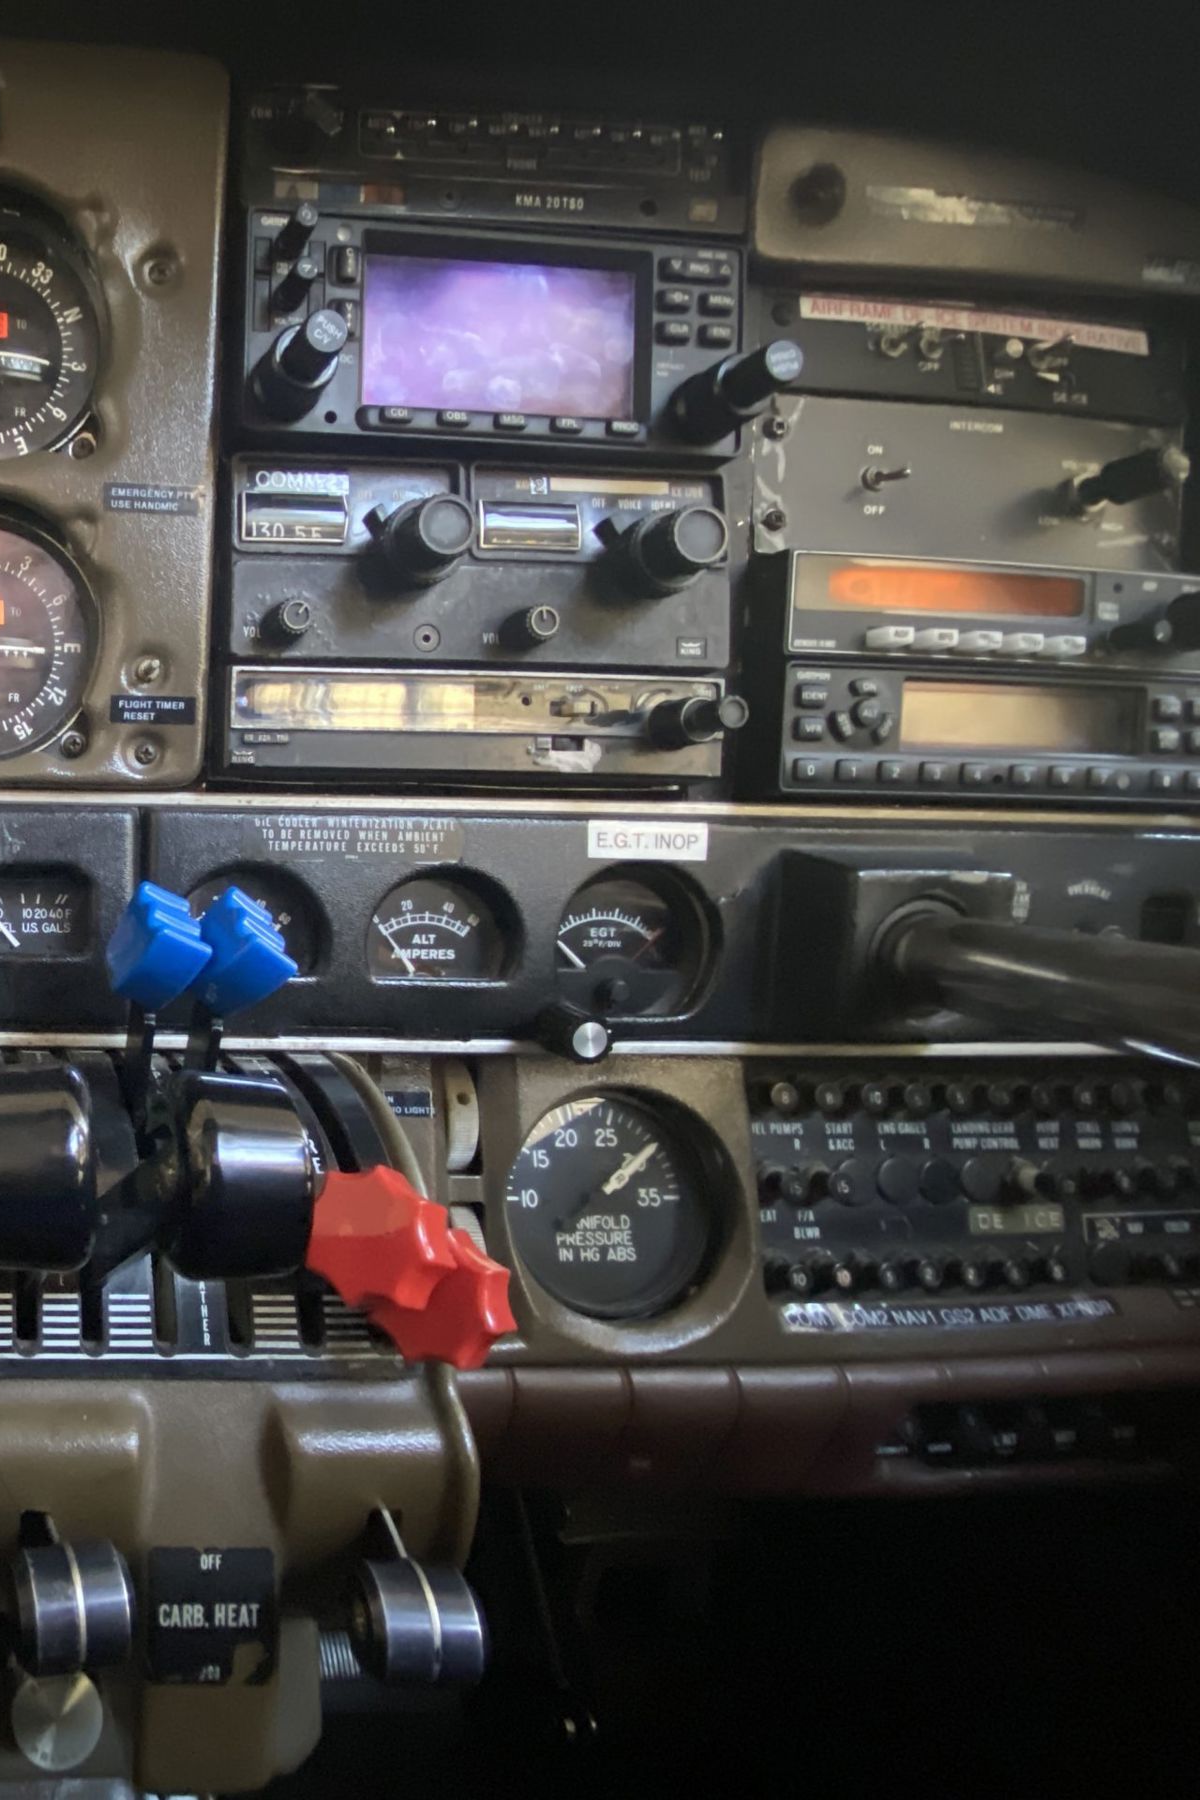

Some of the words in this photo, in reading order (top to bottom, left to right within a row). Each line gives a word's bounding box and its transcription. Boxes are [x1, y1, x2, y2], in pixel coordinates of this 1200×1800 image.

[32, 262, 53, 284] 33
[391, 408, 408, 417] CDI
[446, 411, 466, 420] OBS
[867, 444, 883, 456] ON
[111, 500, 131, 509] USE
[134, 501, 178, 511] HANDMIC
[863, 505, 885, 516] OFF
[679, 645, 701, 655] KING
[863, 682, 877, 691] ON
[802, 690, 828, 699] IDENT
[119, 700, 153, 710] FLIGHT
[156, 701, 184, 710] TIMER
[123, 711, 155, 720] RESET
[262, 829, 275, 840] TO
[280, 829, 295, 840] BE
[299, 829, 350, 841] REMOVED
[359, 830, 389, 842] WHEN
[398, 830, 446, 843] AMBIENT
[597, 832, 649, 849] E.G.T.
[654, 833, 699, 851] INOP
[33, 907, 48, 920] 20
[49, 907, 63, 920] 40
[590, 927, 616, 938] EGT
[411, 934, 437, 945] ALT
[825, 1122, 853, 1135] START
[554, 1129, 577, 1147] 20
[595, 1128, 618, 1147] 25
[532, 1149, 549, 1168] 15
[521, 1189, 538, 1208] 10
[637, 1189, 661, 1207] 35
[977, 1213, 1003, 1229] DE
[1024, 1210, 1062, 1229] ICE
[556, 1231, 633, 1245] PRESSURE
[794, 1227, 820, 1239] BLWR
[559, 1248, 573, 1261] IN
[580, 1248, 600, 1261] HG
[607, 1248, 637, 1261] ABS
[844, 1305, 890, 1327] COM2
[895, 1304, 936, 1325] NAV1
[943, 1308, 974, 1324] GS2
[980, 1305, 1010, 1323] ADF
[1018, 1304, 1053, 1321] DME
[200, 1553, 222, 1571] OFF
[159, 1603, 210, 1628] CARB.
[214, 1603, 260, 1628] HEAT
